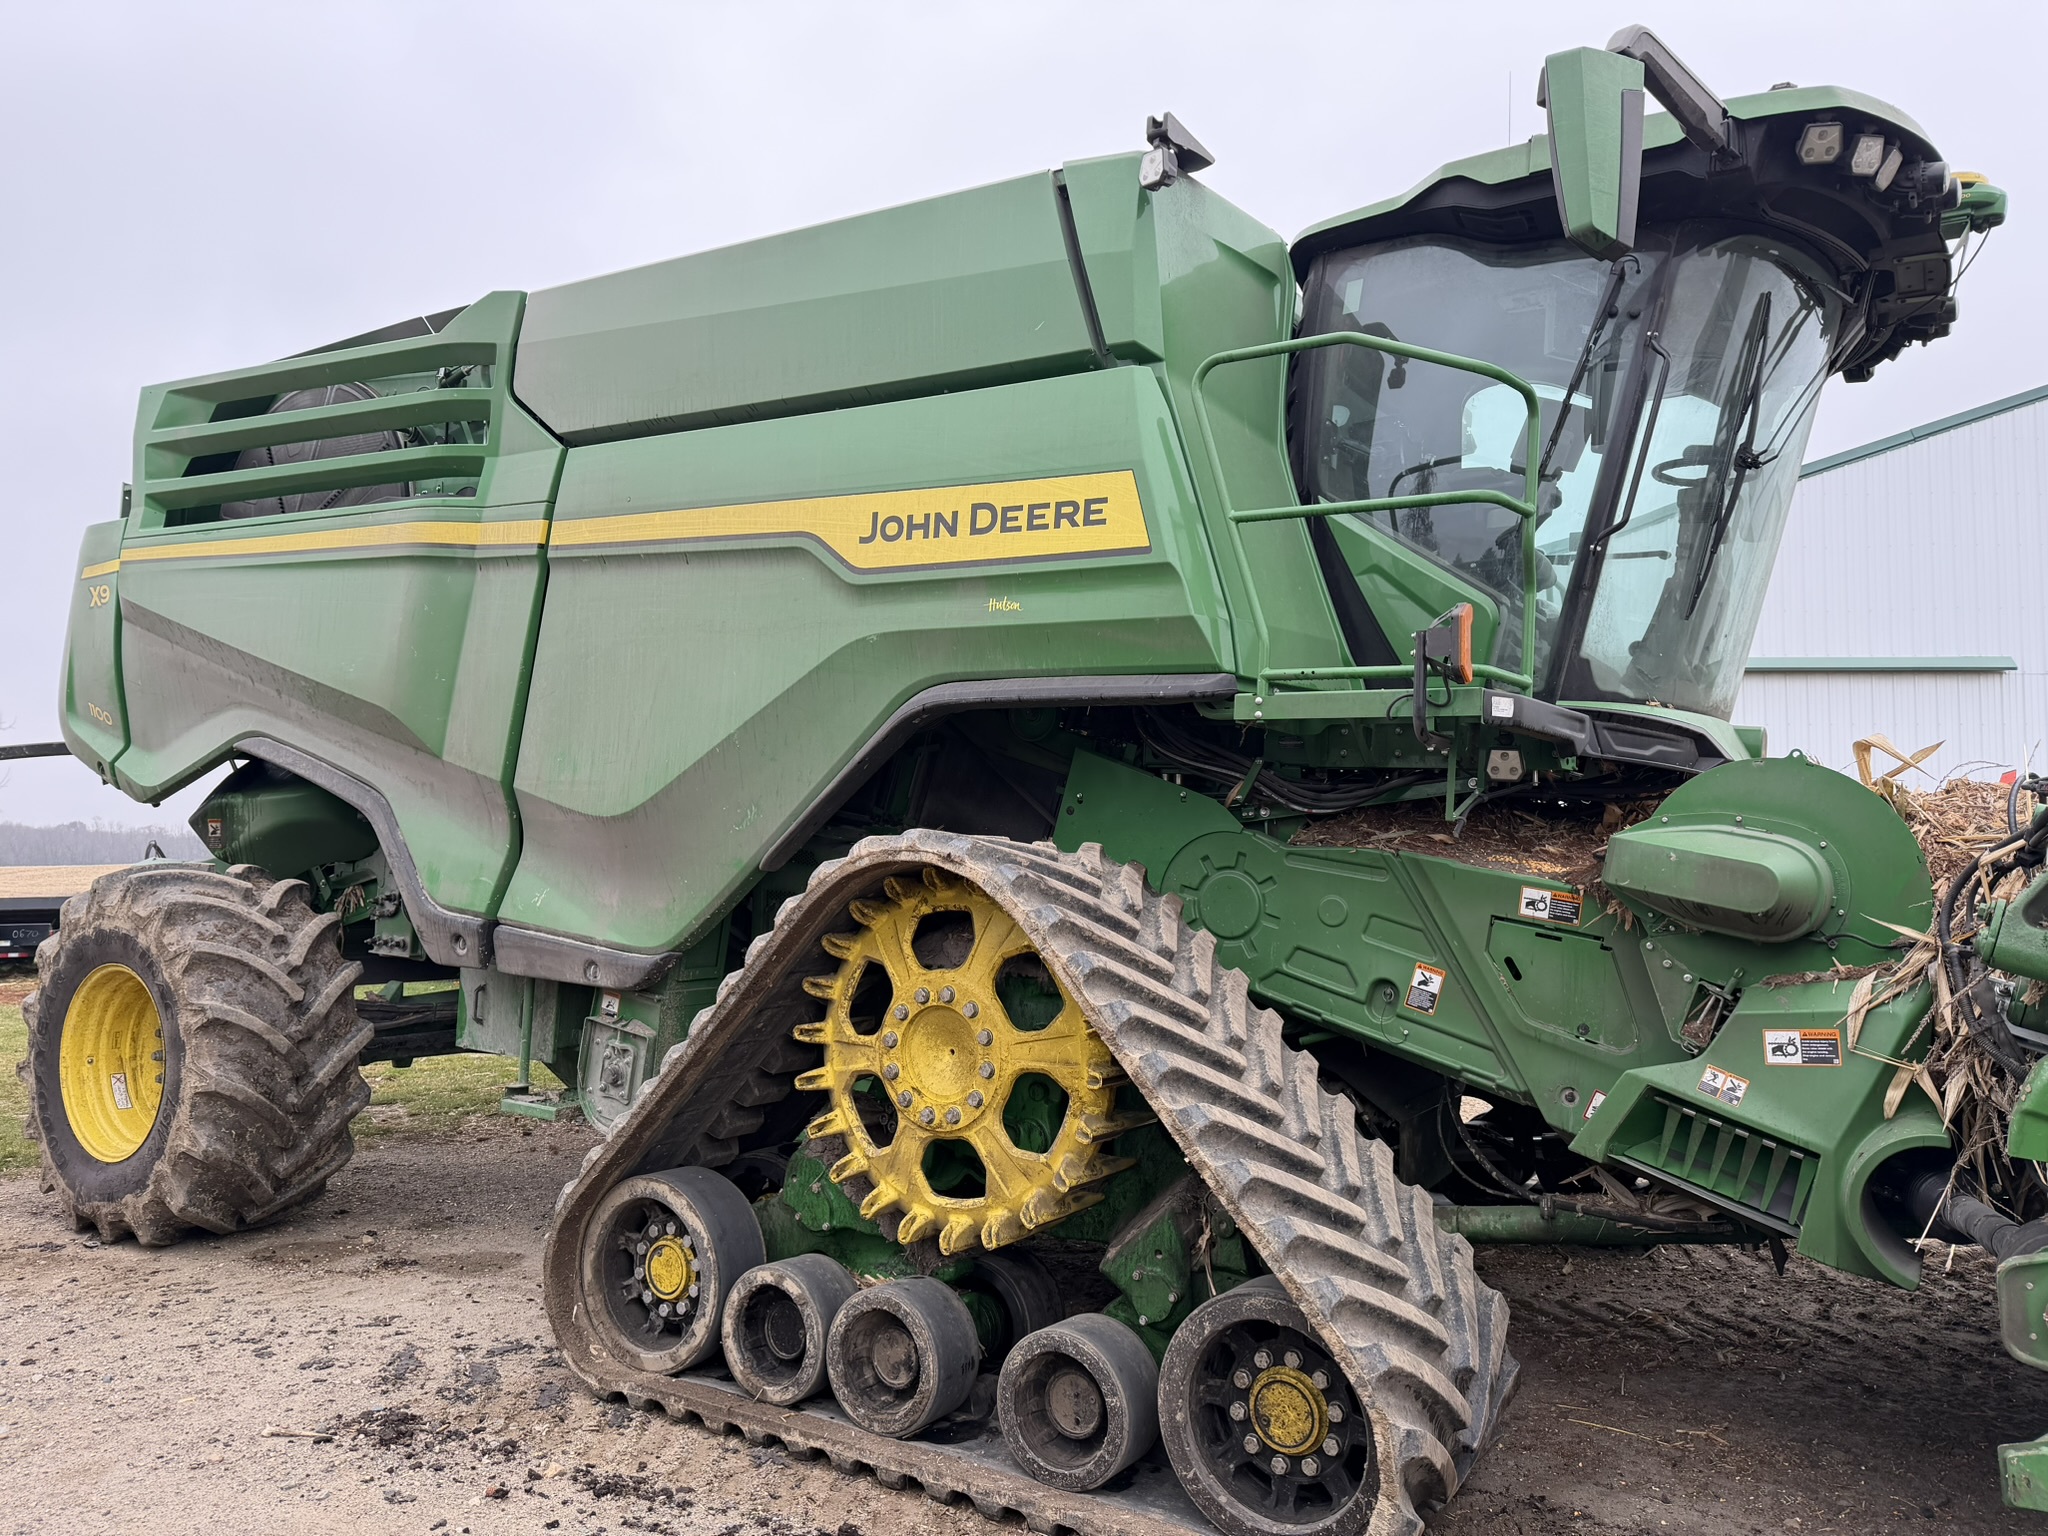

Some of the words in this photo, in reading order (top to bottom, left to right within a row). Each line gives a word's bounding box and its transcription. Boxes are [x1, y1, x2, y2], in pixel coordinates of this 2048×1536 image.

[859, 510, 959, 545] JOHN
[969, 497, 1108, 536] DEERE
[90, 585, 110, 607] X9
[88, 702, 112, 726] 1100
[12, 929, 39, 938] 0670
[1422, 964, 1444, 976] WARNING
